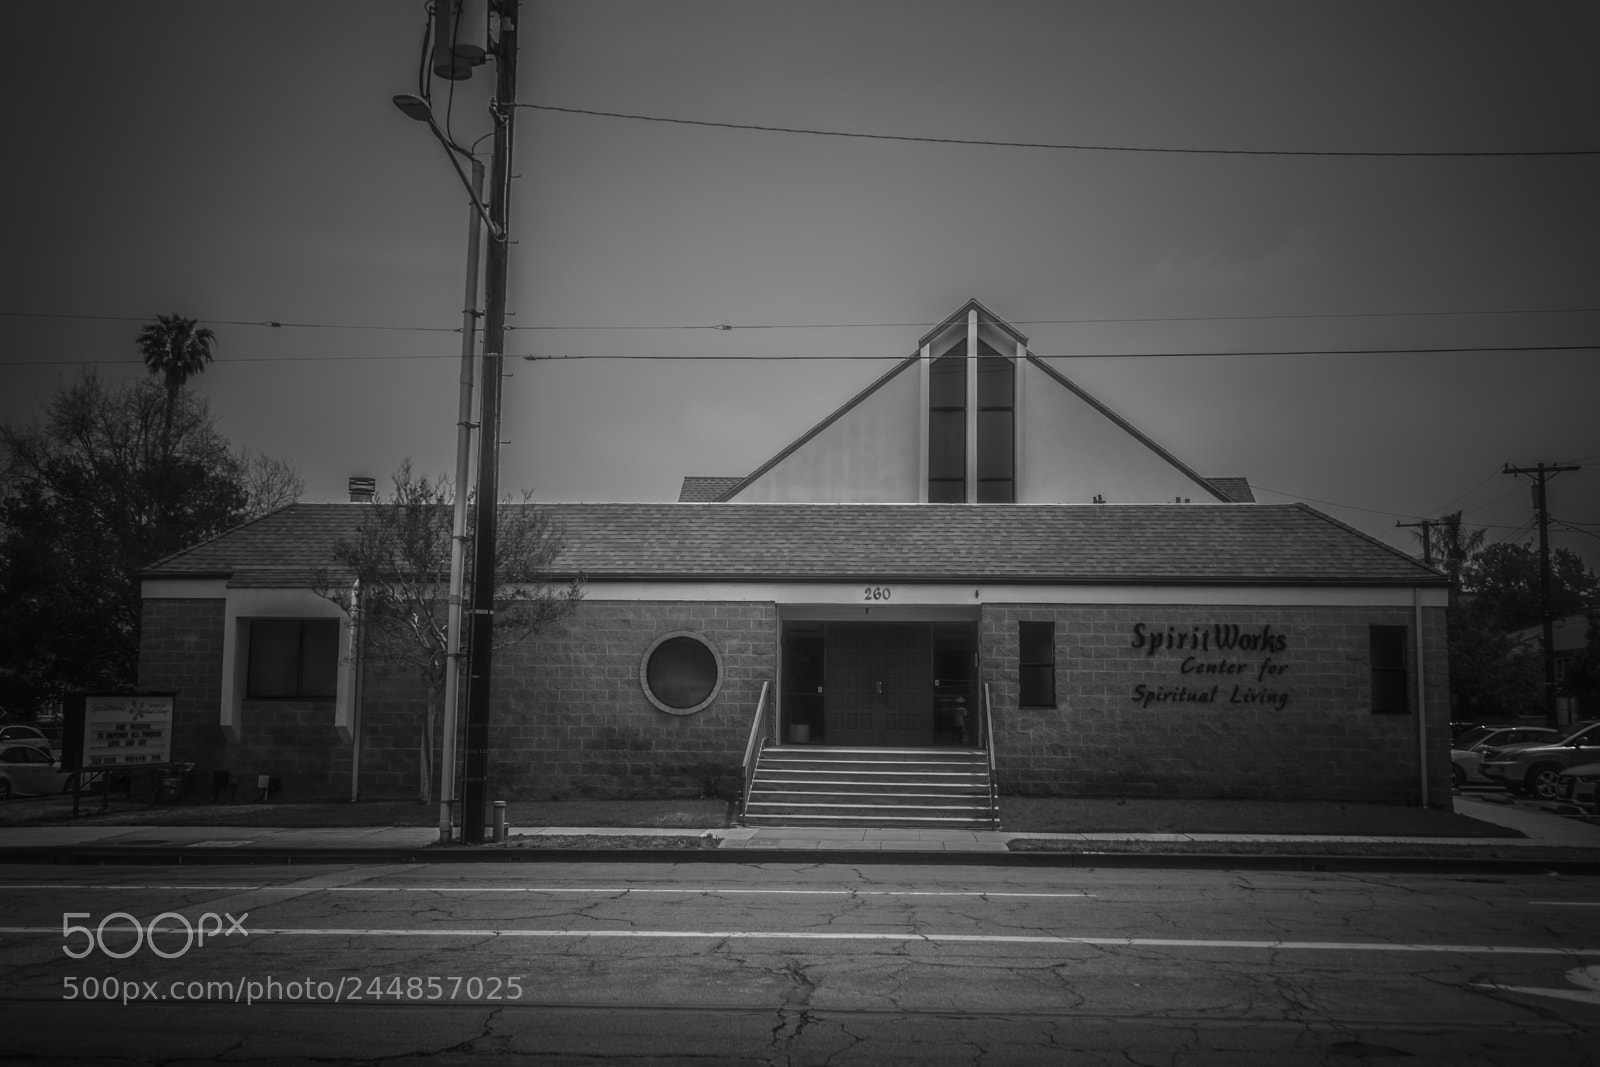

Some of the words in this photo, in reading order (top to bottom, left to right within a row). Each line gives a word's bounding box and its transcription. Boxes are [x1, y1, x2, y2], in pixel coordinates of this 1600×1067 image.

[864, 587, 891, 601] 260
[1132, 623, 1287, 656] SpiritWorks
[1180, 656, 1248, 675] Center
[1257, 657, 1289, 683] for
[1132, 684, 1218, 709] Spiritual
[1230, 685, 1289, 711] Living
